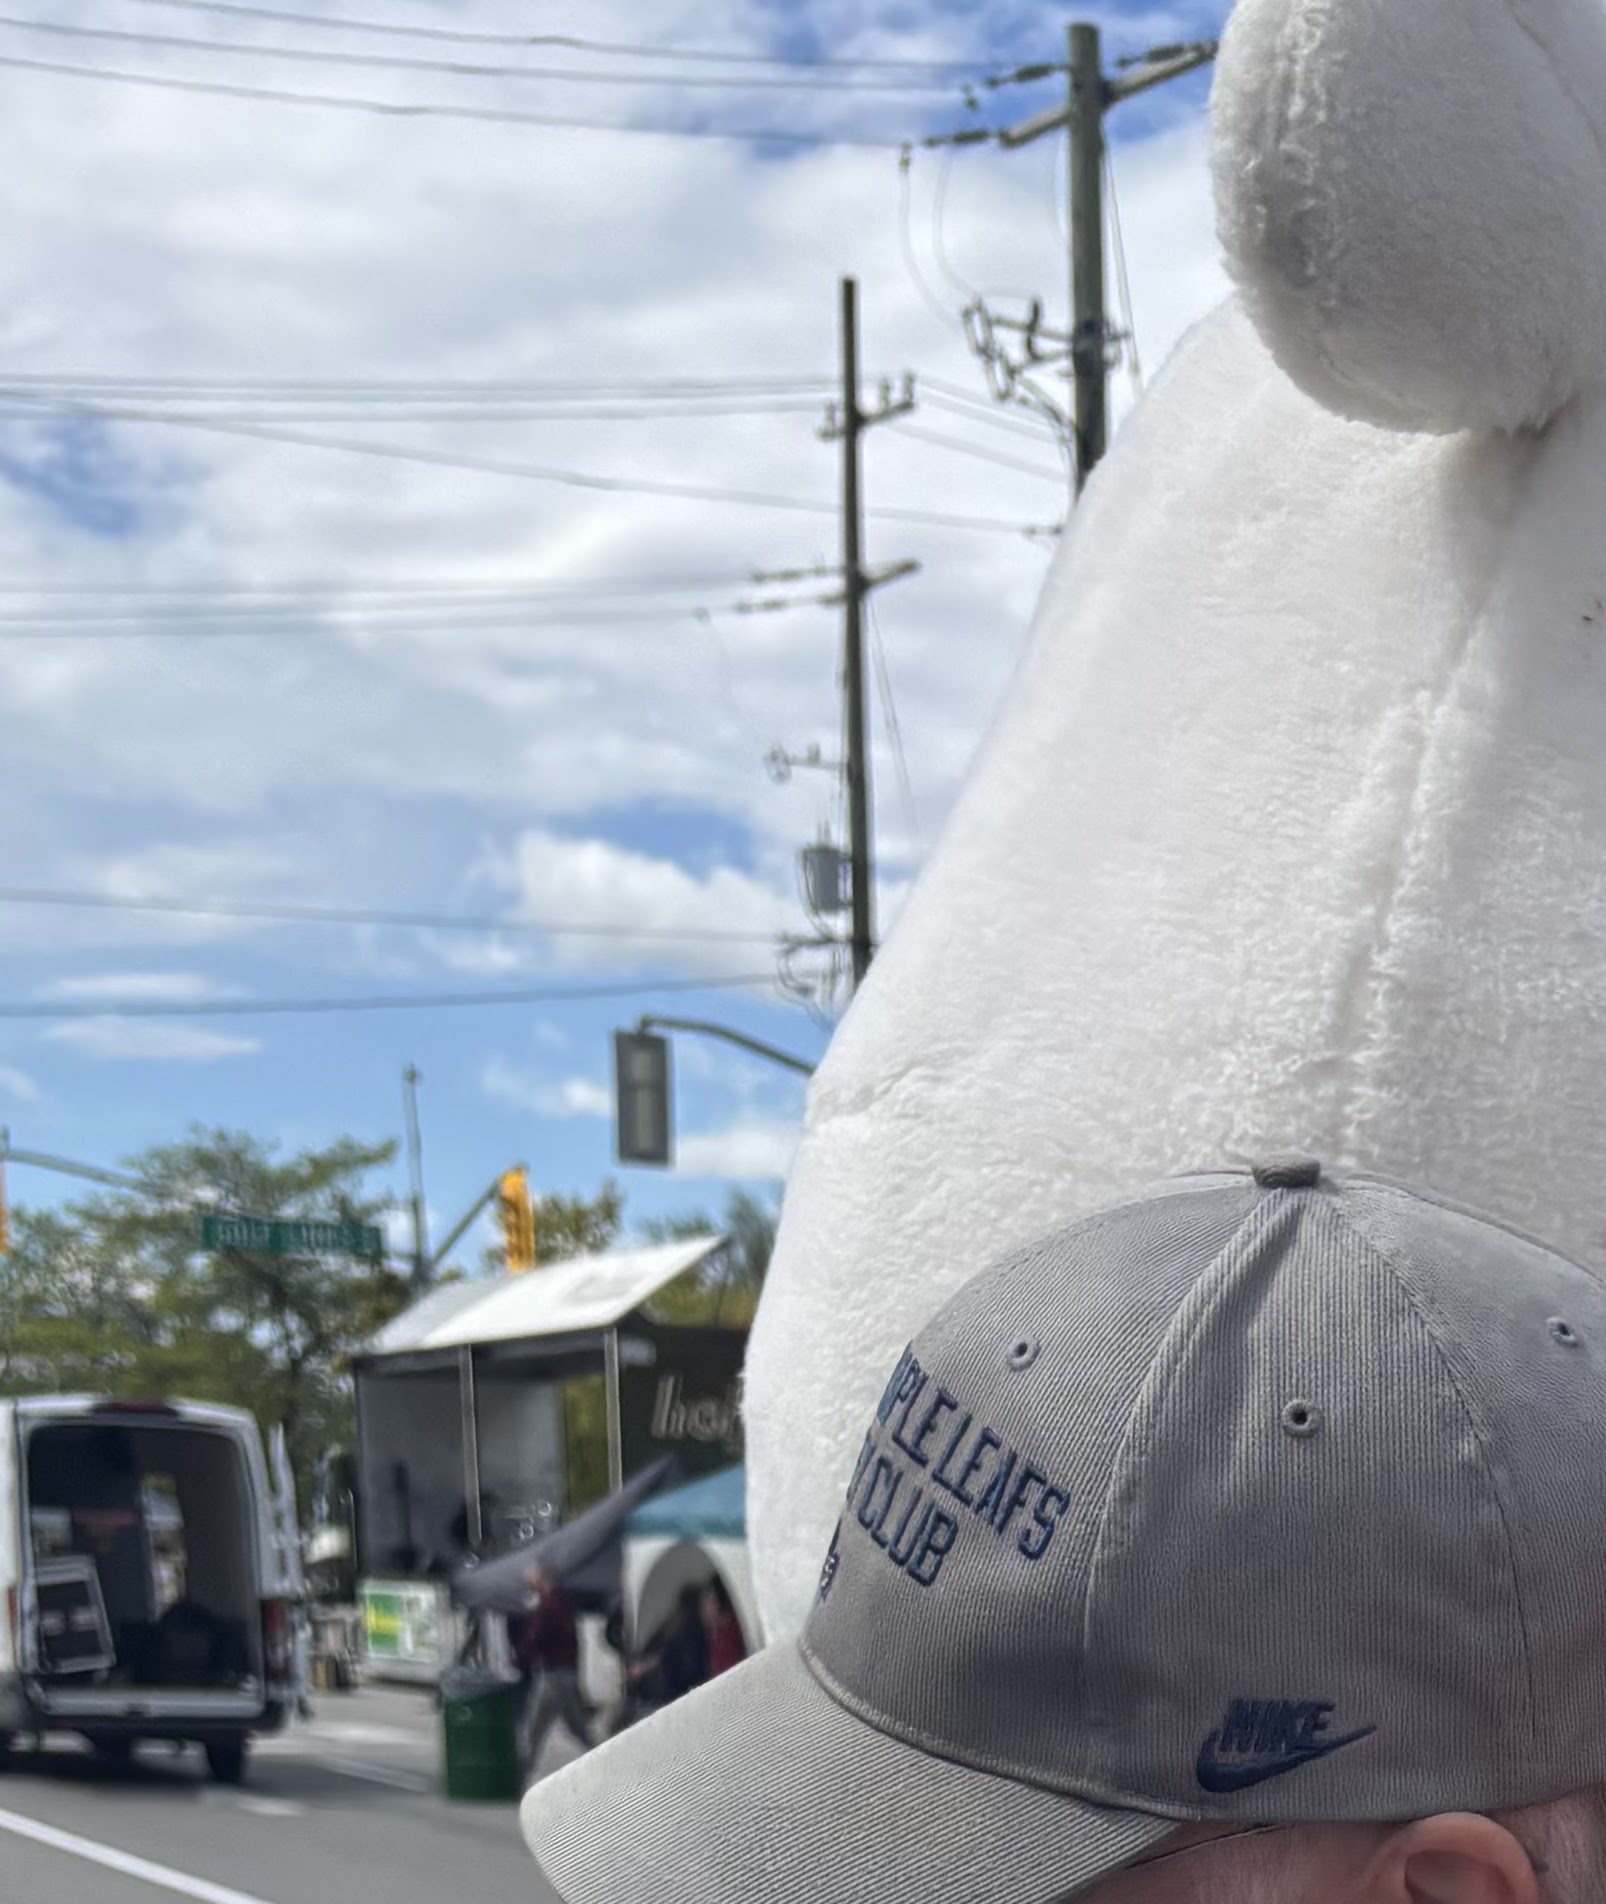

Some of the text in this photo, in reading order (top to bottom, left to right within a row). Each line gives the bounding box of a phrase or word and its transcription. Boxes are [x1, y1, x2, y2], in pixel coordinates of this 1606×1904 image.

[876, 1340, 959, 1469] PLE
[931, 1411, 1072, 1561] LEAFS
[857, 1455, 959, 1588] CLUB
[1219, 1699, 1336, 1753] NIKE
